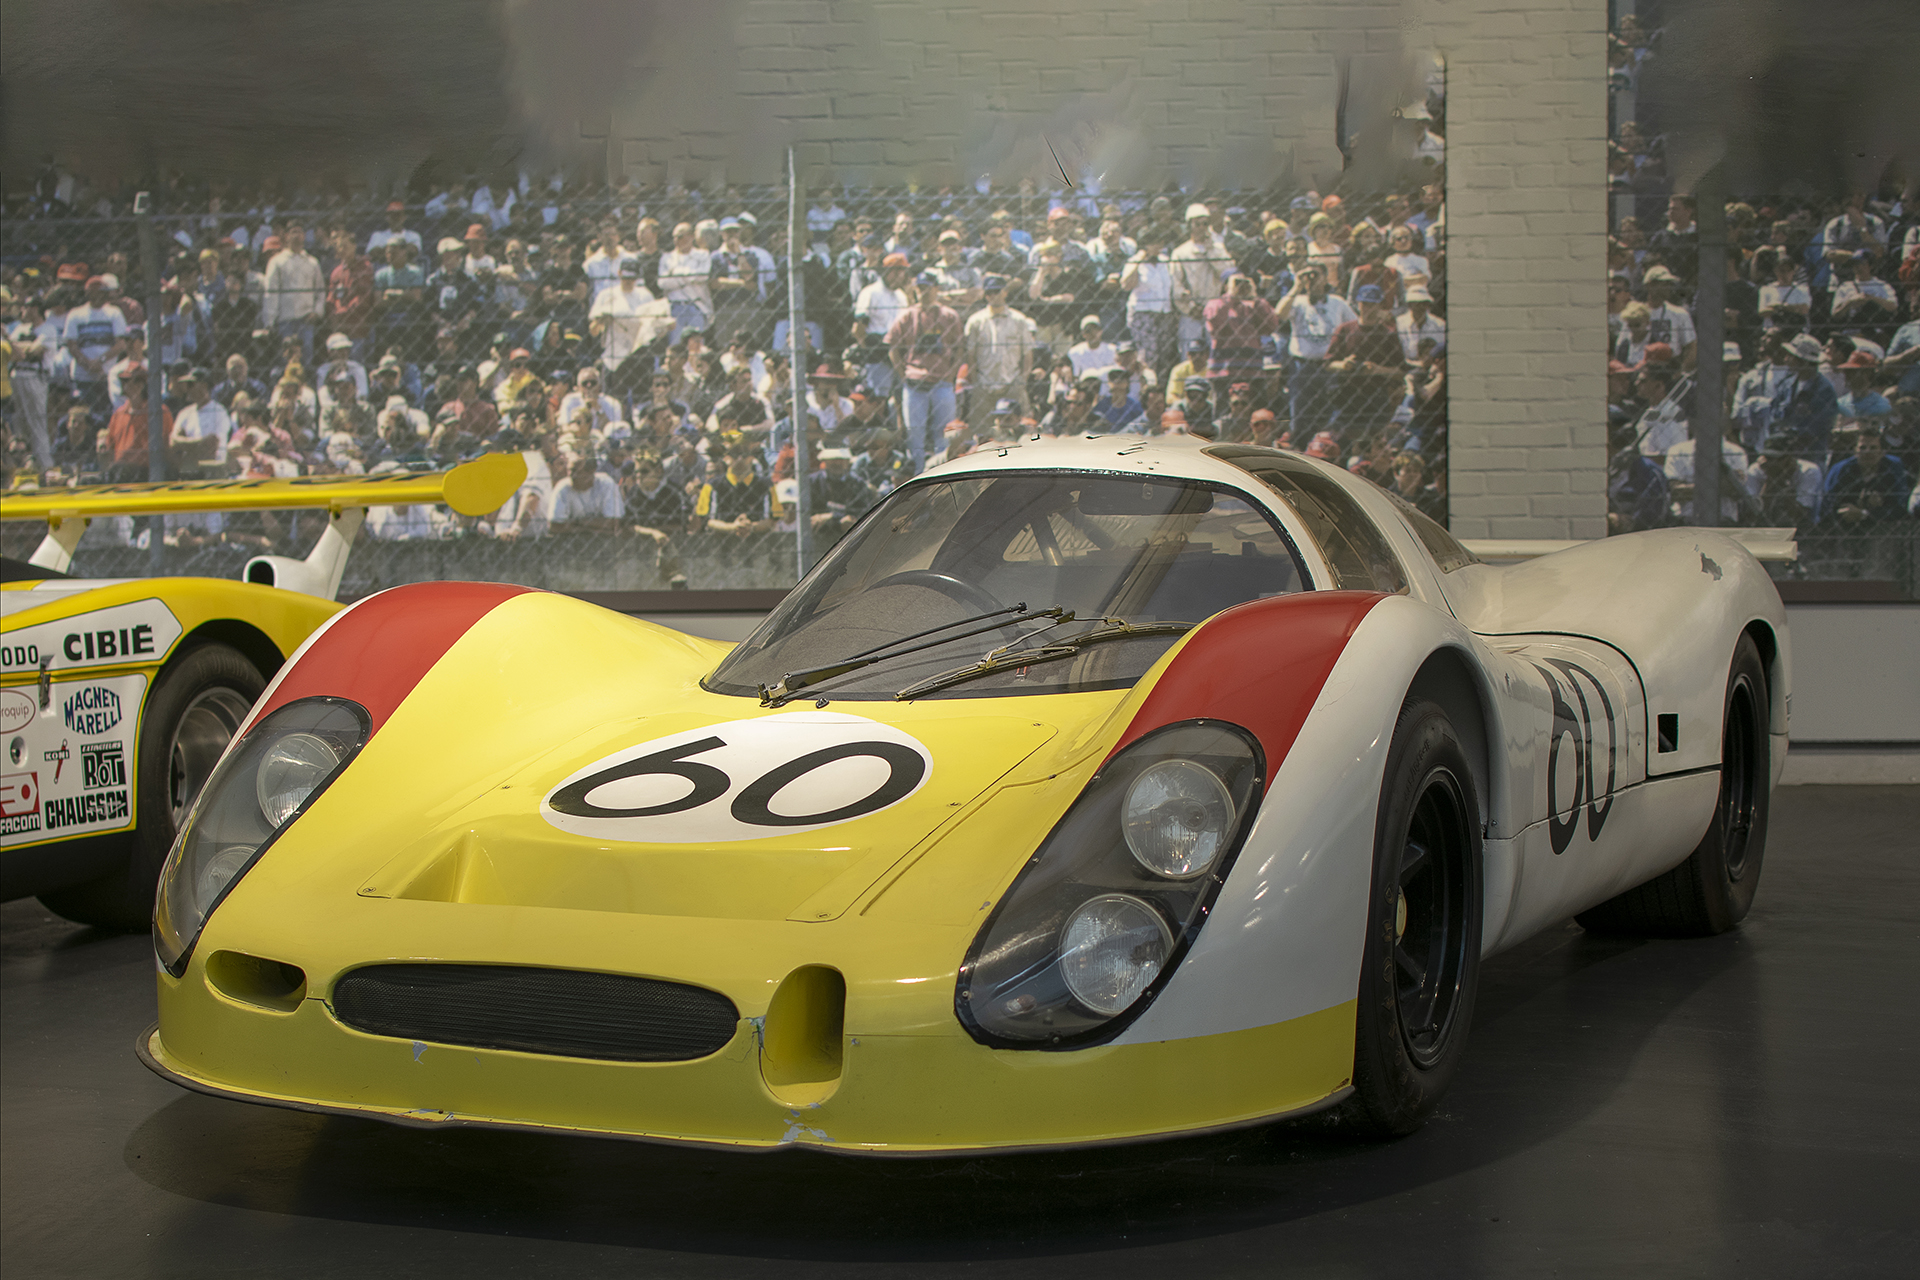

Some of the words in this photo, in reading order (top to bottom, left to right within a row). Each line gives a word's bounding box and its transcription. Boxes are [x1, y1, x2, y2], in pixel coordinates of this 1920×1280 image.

[63, 686, 122, 716] MAGNETI
[63, 709, 122, 735] MARELLI
[45, 750, 70, 761] KONI
[1529, 658, 1616, 855] 60
[548, 736, 926, 827] 60
[0, 814, 40, 834] FACOM
[44, 790, 129, 830] CHAUSSON
